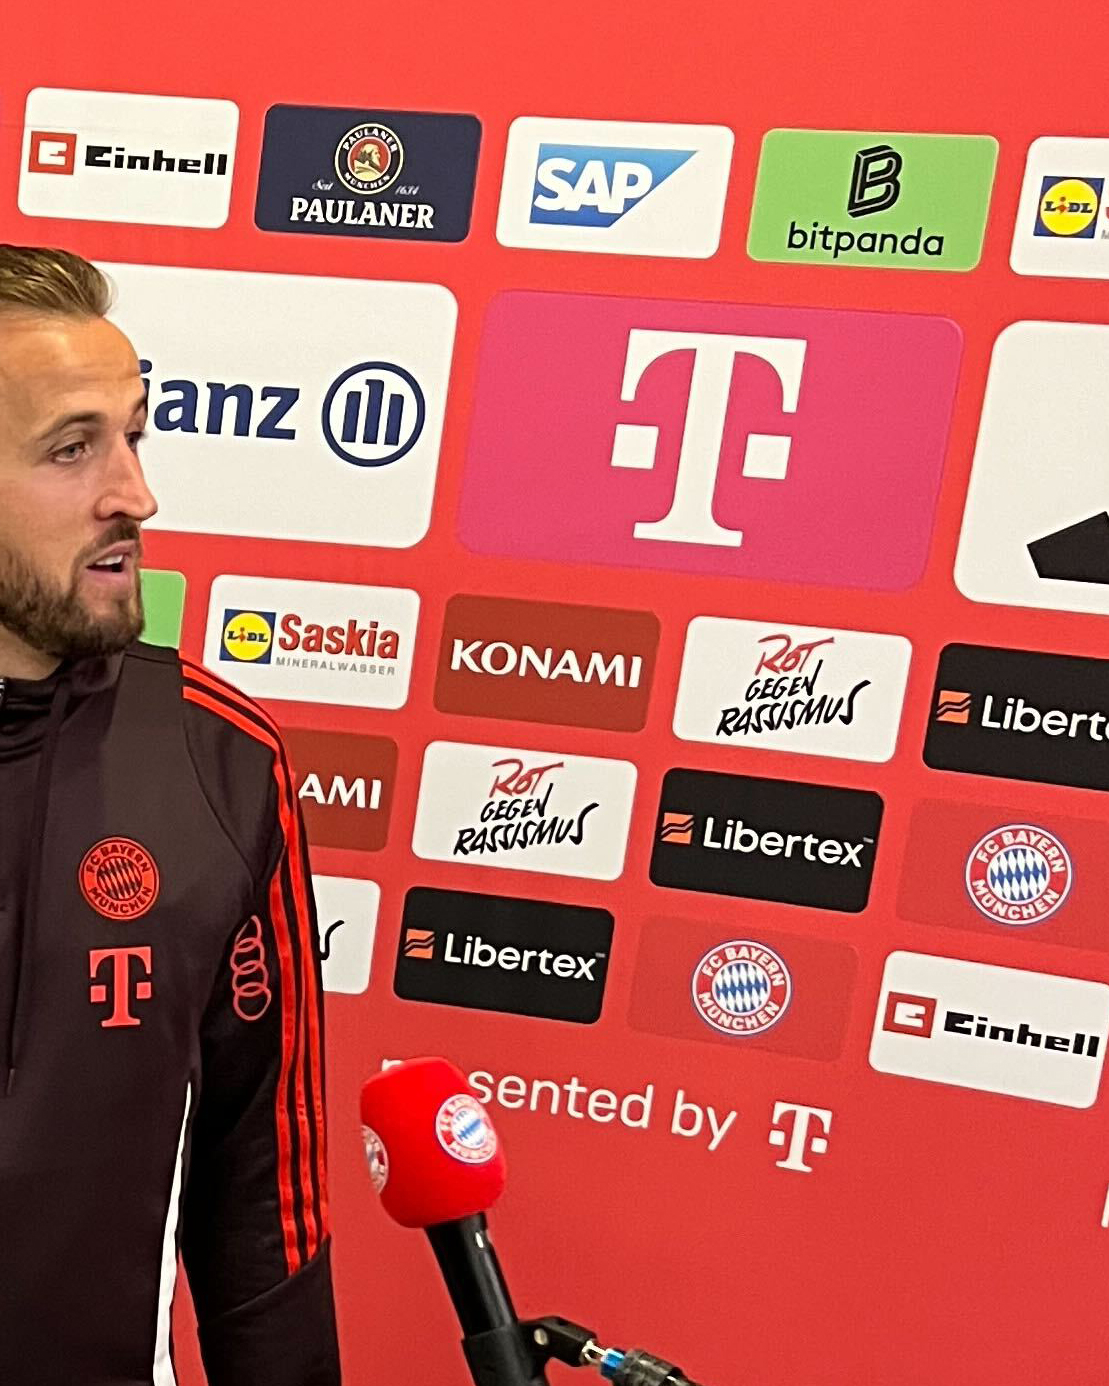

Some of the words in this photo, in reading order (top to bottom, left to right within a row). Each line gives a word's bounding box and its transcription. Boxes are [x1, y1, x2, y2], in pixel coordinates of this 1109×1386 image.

[343, 128, 398, 152] PAULANER
[85, 146, 228, 176] Einhell
[533, 157, 653, 214] SAP
[290, 197, 434, 229] PAULANER
[787, 221, 945, 259] bitpanda
[278, 613, 400, 660] Saskia
[755, 634, 835, 675] ROT
[276, 656, 395, 676] MINERALWASSER
[451, 639, 642, 688] KONAMI
[745, 660, 824, 702] GEGEN
[715, 680, 872, 737] RASSISMUS
[981, 695, 1109, 741] Libert
[298, 773, 382, 810] AMI
[490, 759, 565, 797] ROT
[480, 783, 554, 823] GEGEN
[453, 802, 600, 855] RASSISMUS
[976, 839, 999, 863] FC
[1001, 831, 1066, 873] BAYERN
[701, 955, 723, 977] FC
[724, 946, 785, 987] BAYERN
[943, 1010, 1100, 1058] Einhell
[468, 1070, 654, 1130] sented
[671, 1089, 737, 1151] by
